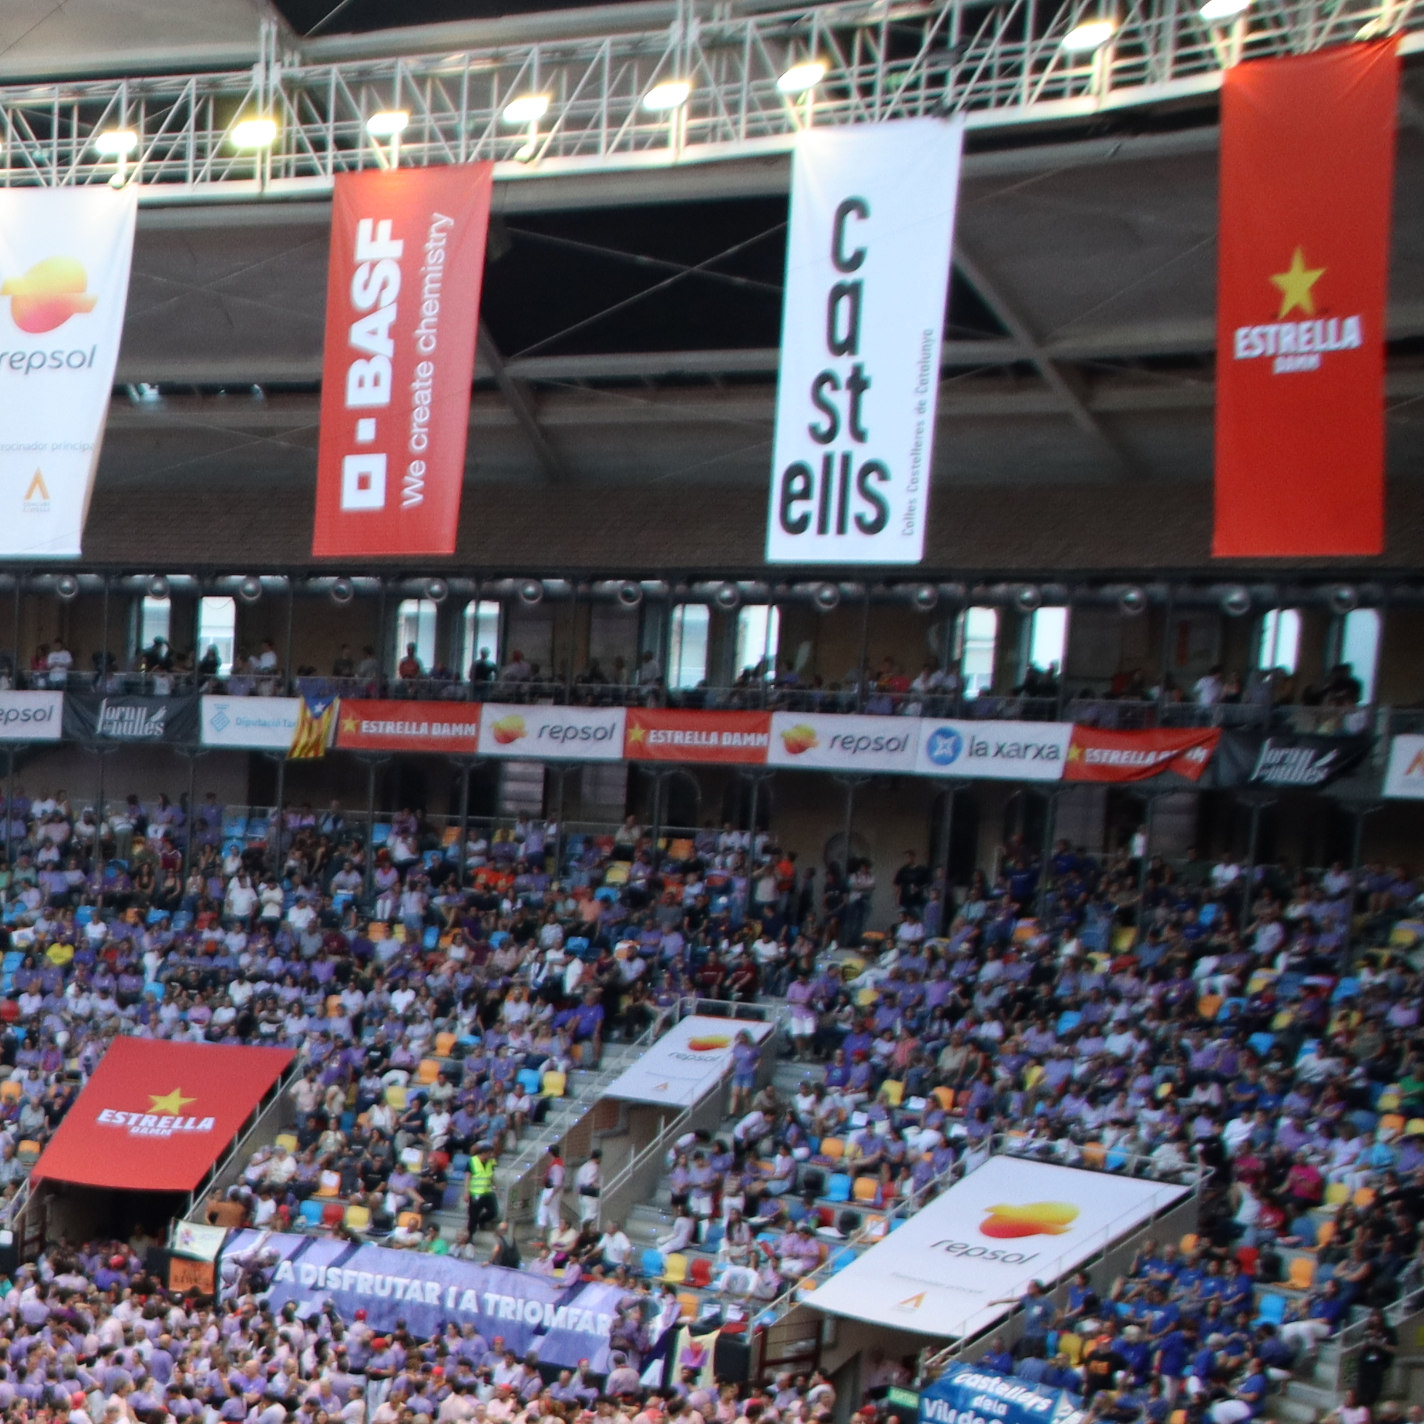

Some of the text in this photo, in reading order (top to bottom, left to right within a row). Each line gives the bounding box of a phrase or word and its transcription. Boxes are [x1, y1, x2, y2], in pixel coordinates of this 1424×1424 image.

[345, 217, 404, 408] BASF
[1234, 315, 1363, 360] ESTRELLA
[400, 211, 455, 508] We create chemistry
[51, 441, 94, 454] princip
[361, 720, 476, 737] ESTRELLA DAMM
[538, 723, 617, 743] repsol
[647, 730, 768, 746] ESTRELLA DAMM
[830, 734, 910, 754] repsol
[968, 736, 1061, 760] la xarxa
[1084, 747, 1160, 767] ESTRELLA
[97, 1108, 215, 1130] ESTRELLA
[129, 1126, 172, 1137] DAMM
[930, 1239, 1040, 1265] repsol
[273, 1260, 612, 1338] A DISFRUTAR I A TRIOMFAR
